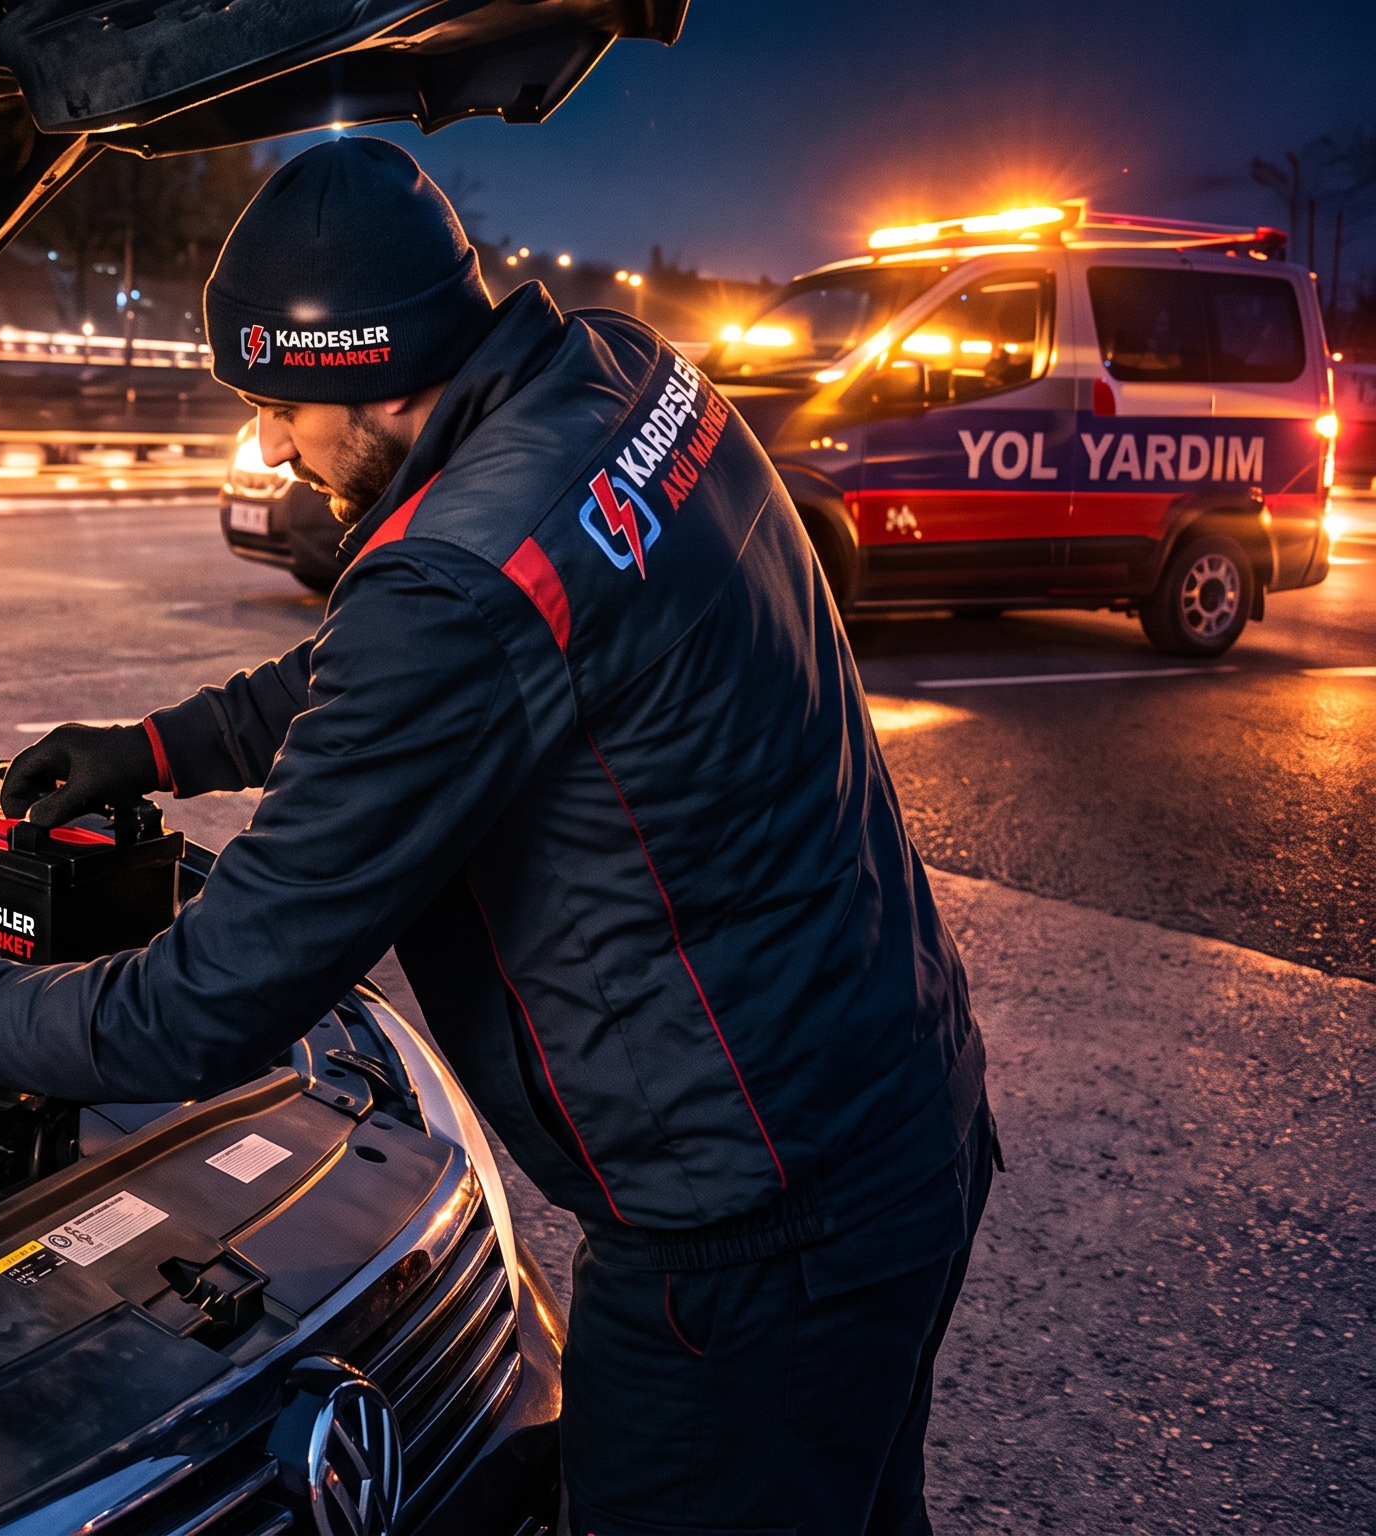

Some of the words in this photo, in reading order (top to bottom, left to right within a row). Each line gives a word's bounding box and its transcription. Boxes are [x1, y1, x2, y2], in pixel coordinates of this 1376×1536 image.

[276, 325, 389, 350] KARDEŞLER
[283, 350, 316, 367] AKÜ
[321, 347, 390, 366] MARKET
[660, 450, 699, 511] AKÜ
[688, 390, 729, 468] MARKET
[958, 430, 1057, 480] YOL
[1081, 432, 1264, 482] YARDIM
